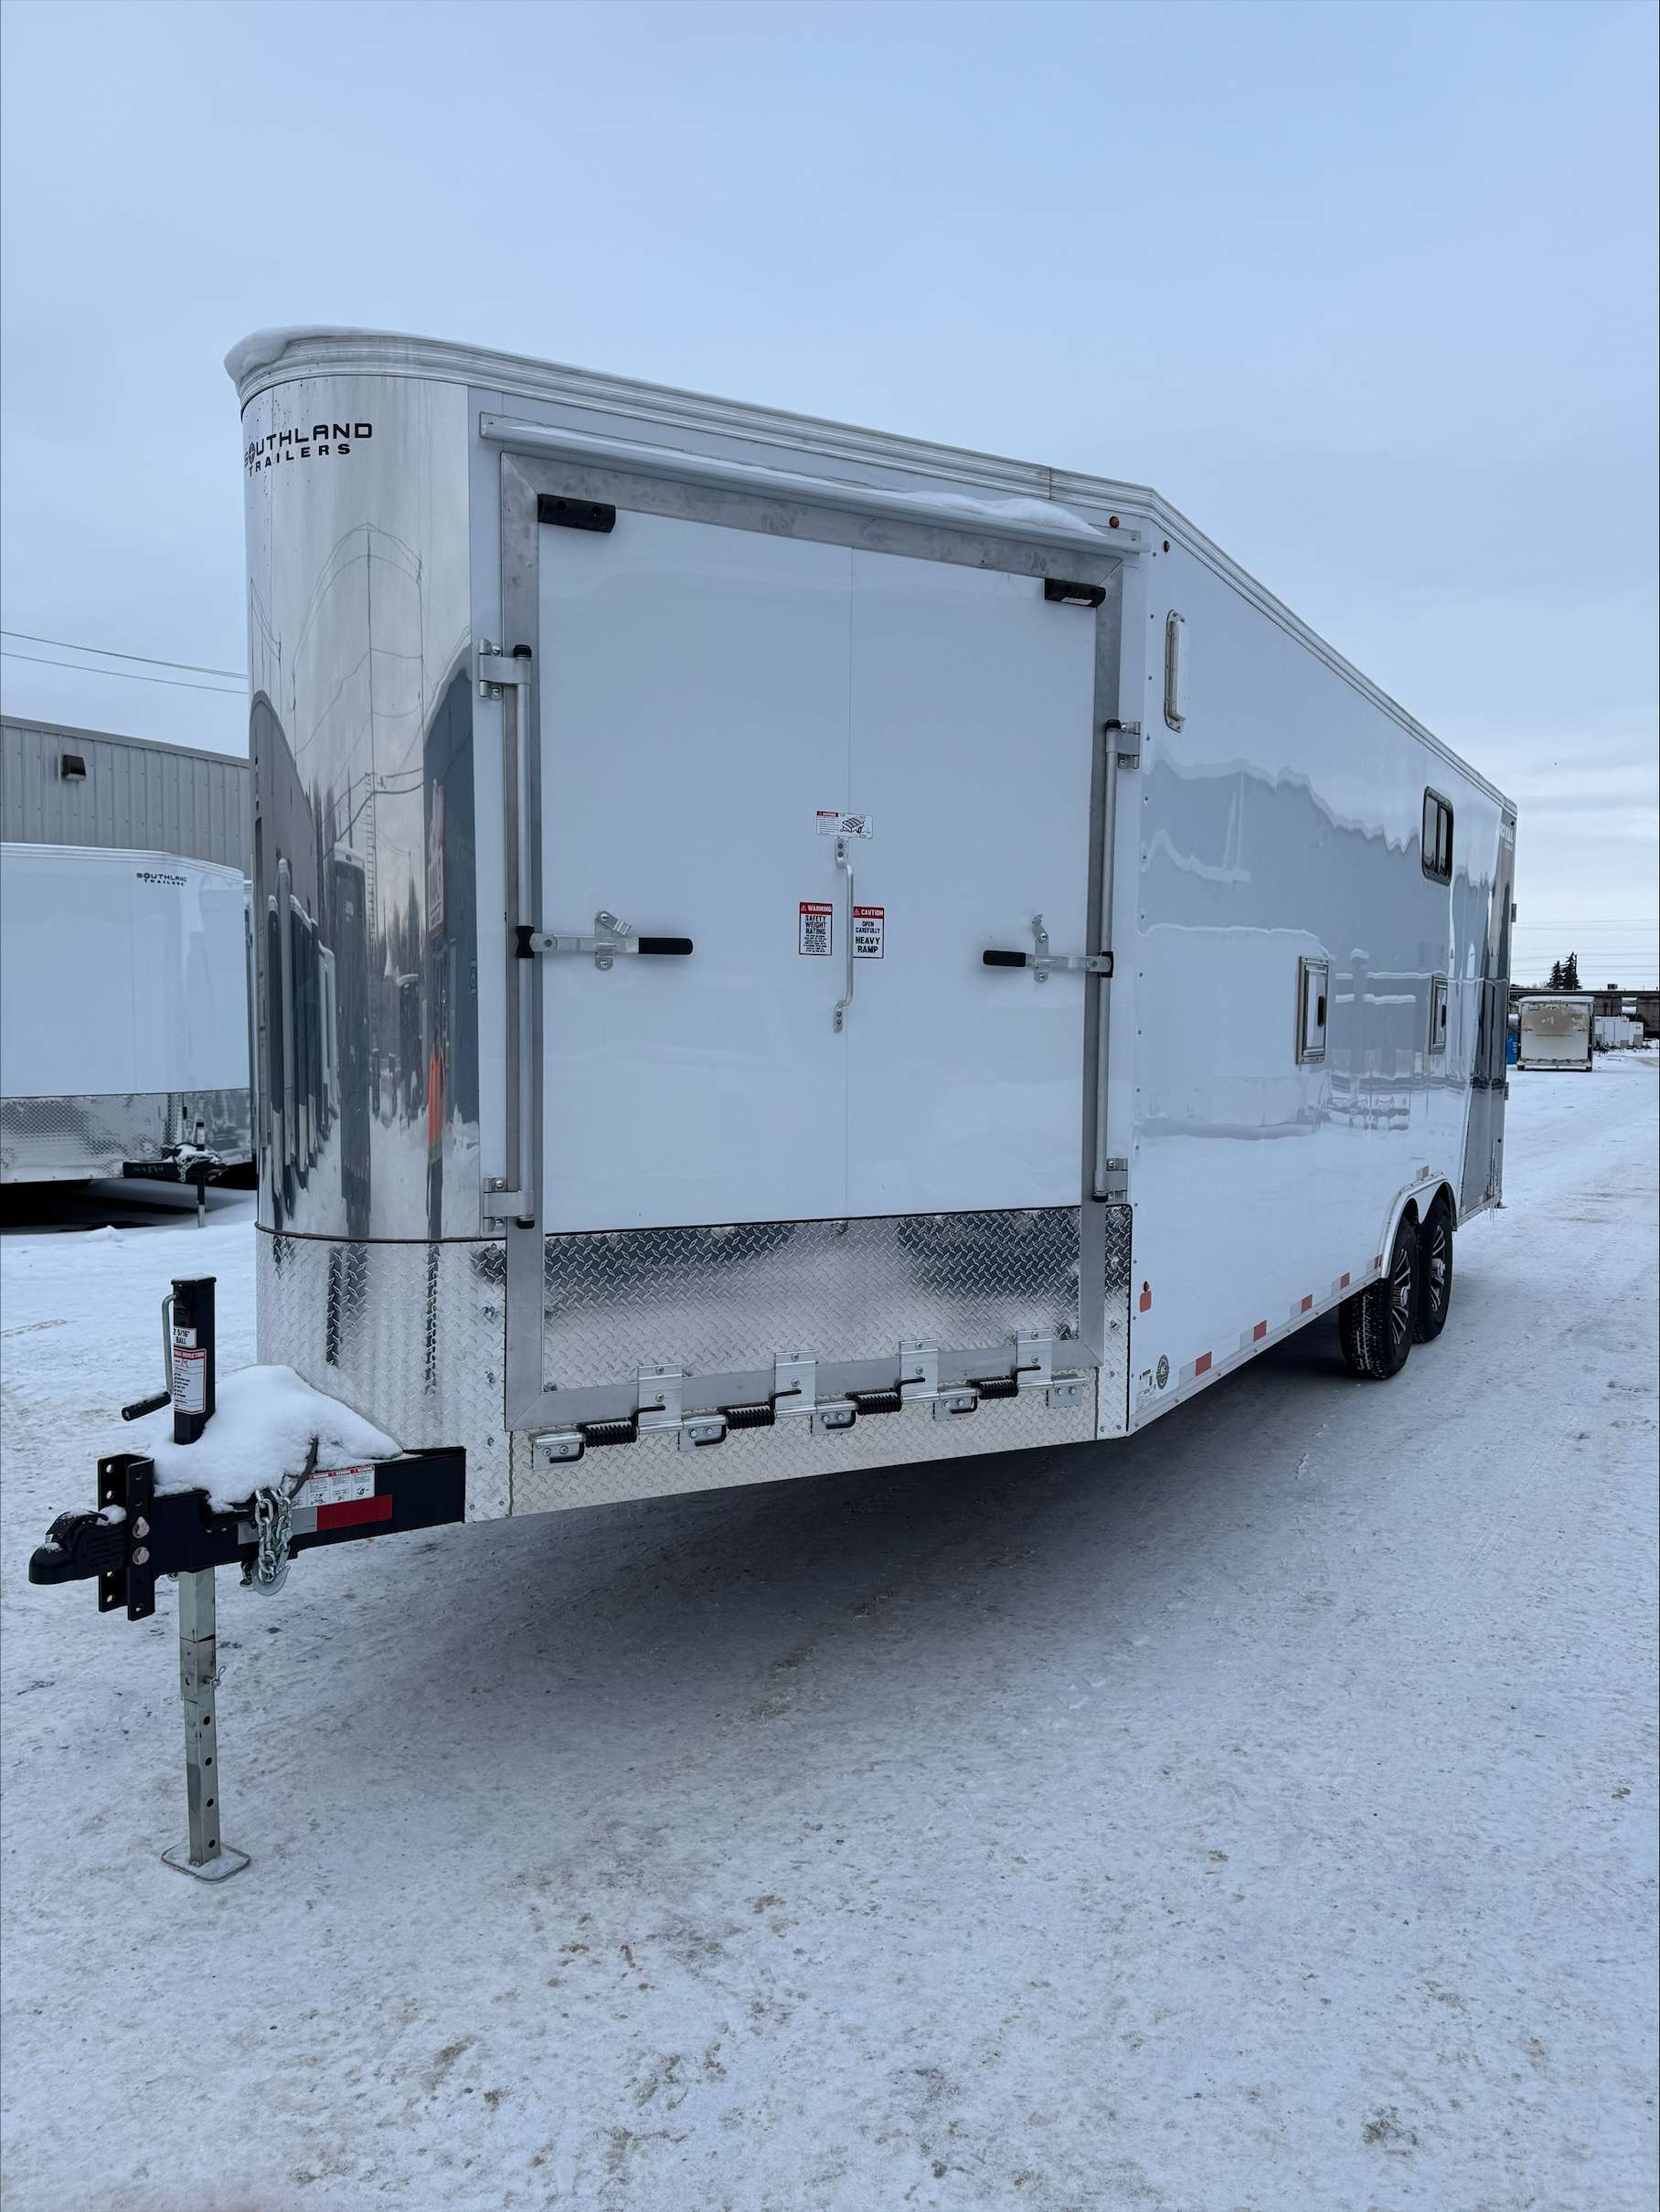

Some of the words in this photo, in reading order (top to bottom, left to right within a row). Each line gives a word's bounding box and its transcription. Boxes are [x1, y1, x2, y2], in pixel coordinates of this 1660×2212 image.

[244, 422, 372, 467] SOUTHLAND
[249, 443, 351, 476] TRAILERS
[856, 937, 880, 945] HEAVY
[857, 945, 878, 953] RAMP
